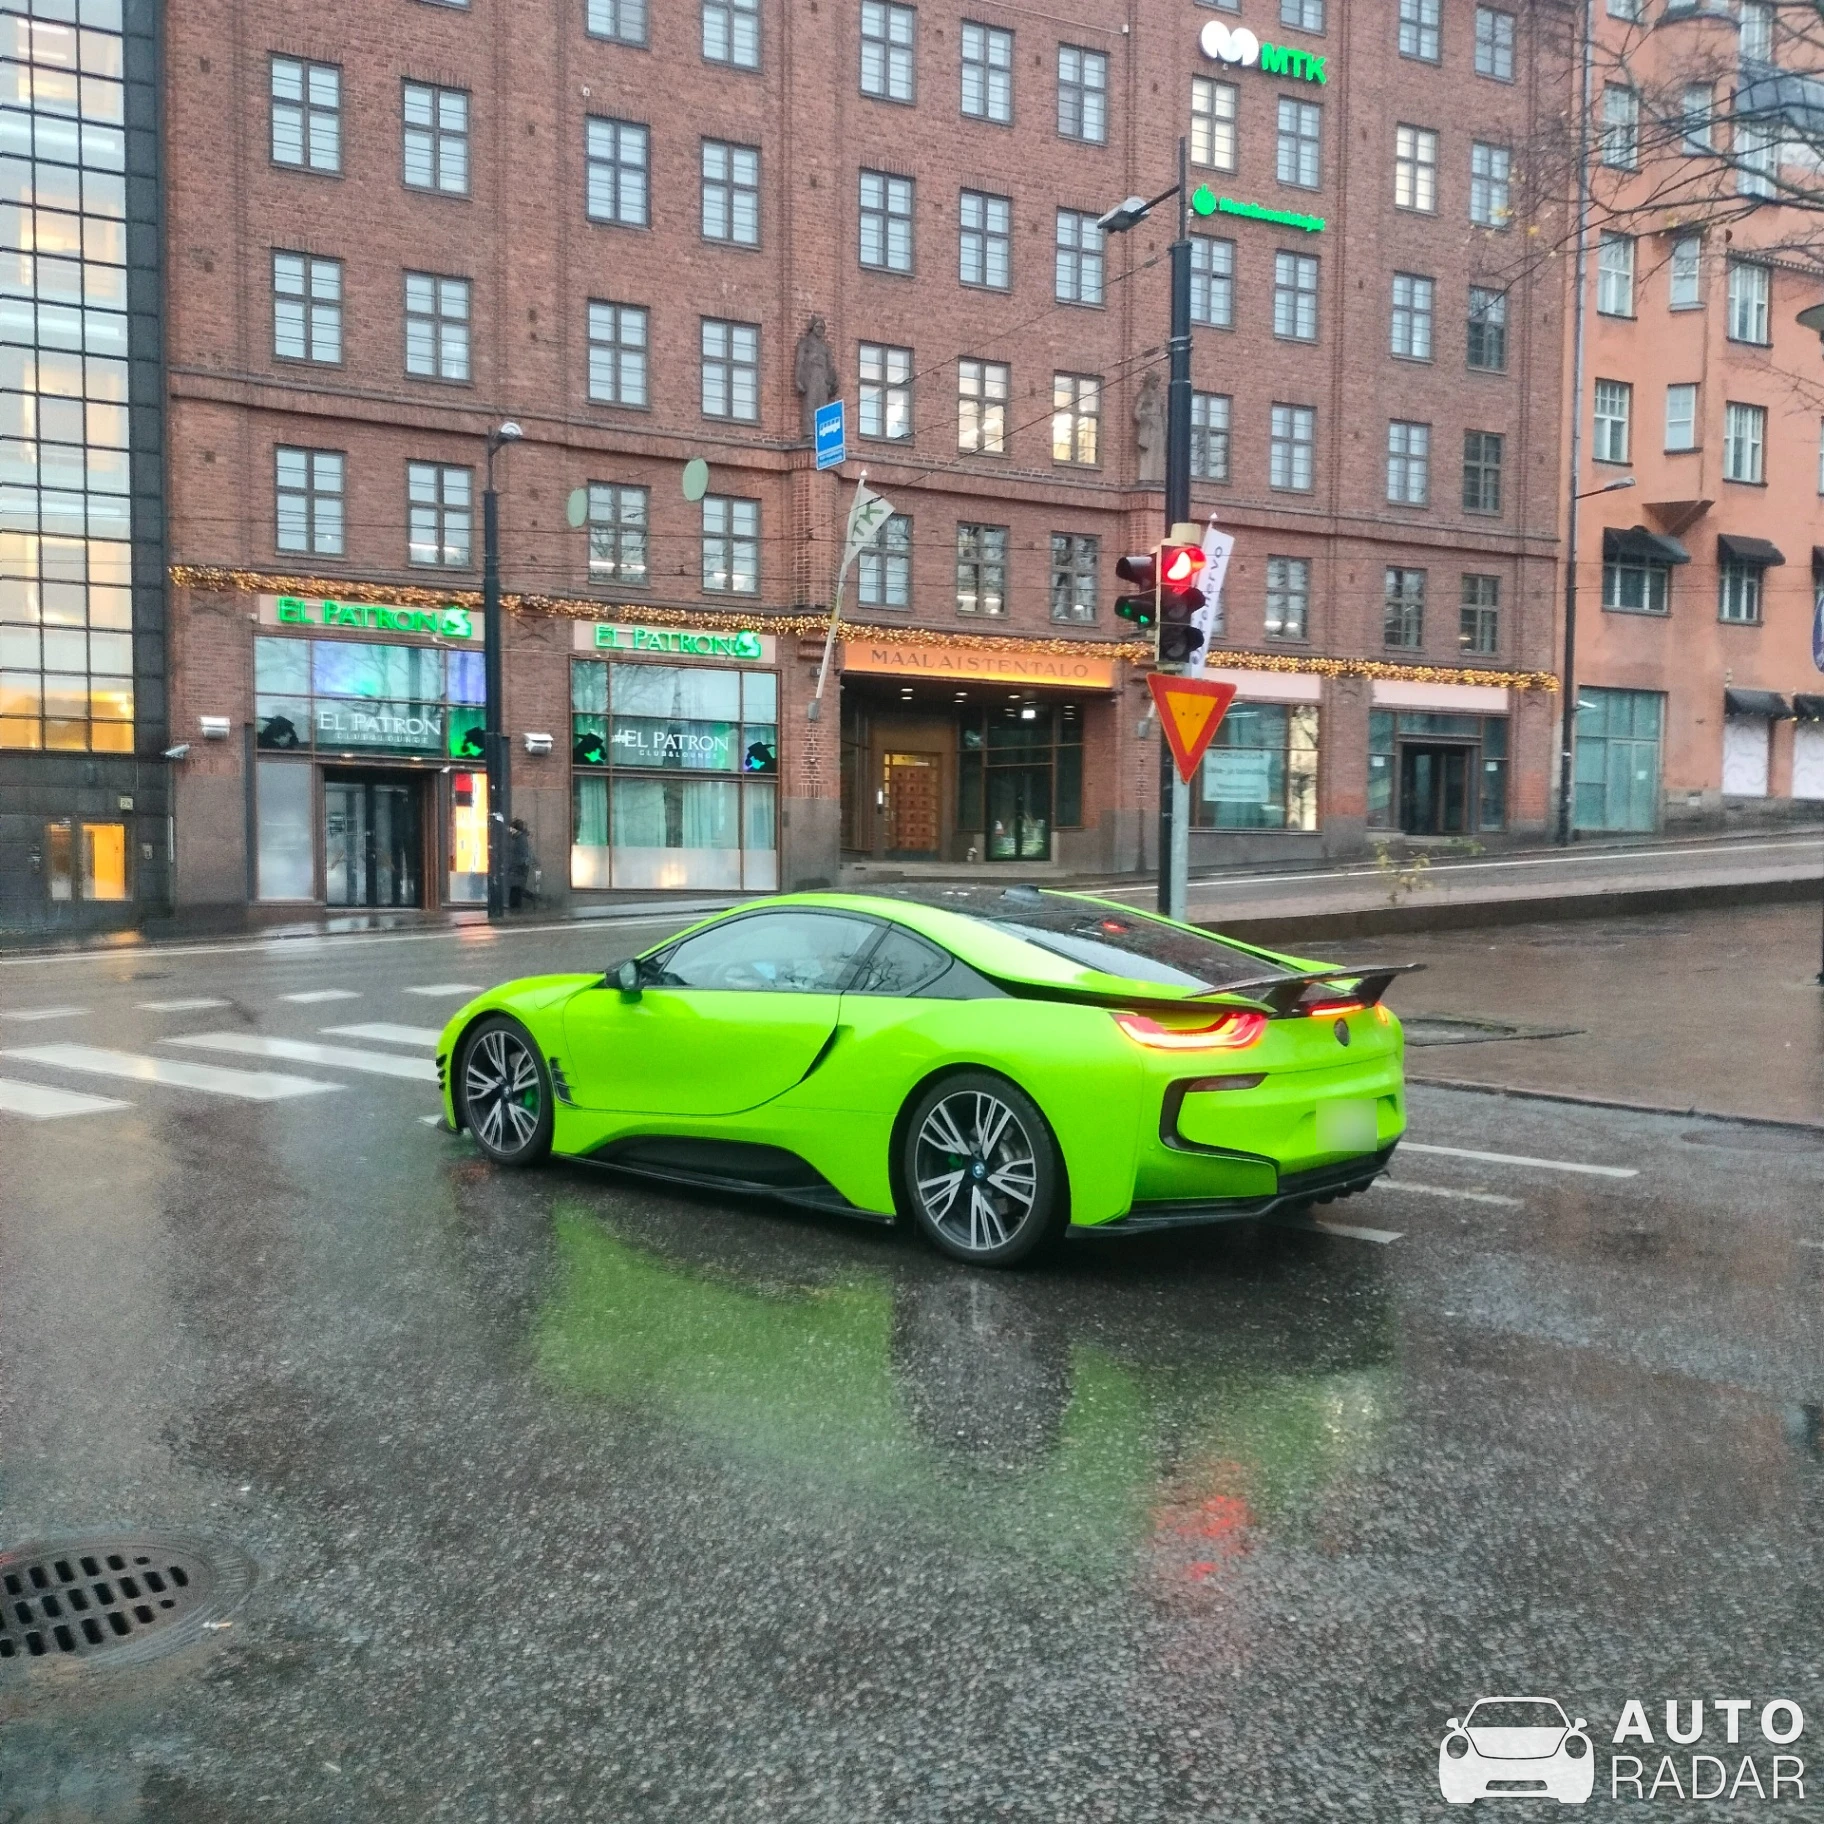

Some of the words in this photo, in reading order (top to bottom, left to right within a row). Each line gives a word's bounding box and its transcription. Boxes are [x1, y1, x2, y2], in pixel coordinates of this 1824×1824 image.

[1261, 42, 1326, 84] MTK
[277, 596, 315, 624] EL
[322, 599, 438, 632] PATRON
[594, 624, 624, 649] EL
[633, 627, 733, 656] PATRON
[319, 711, 347, 732] EL
[352, 714, 441, 736] PATRON
[624, 729, 648, 748] EL
[653, 732, 729, 752] PATRON
